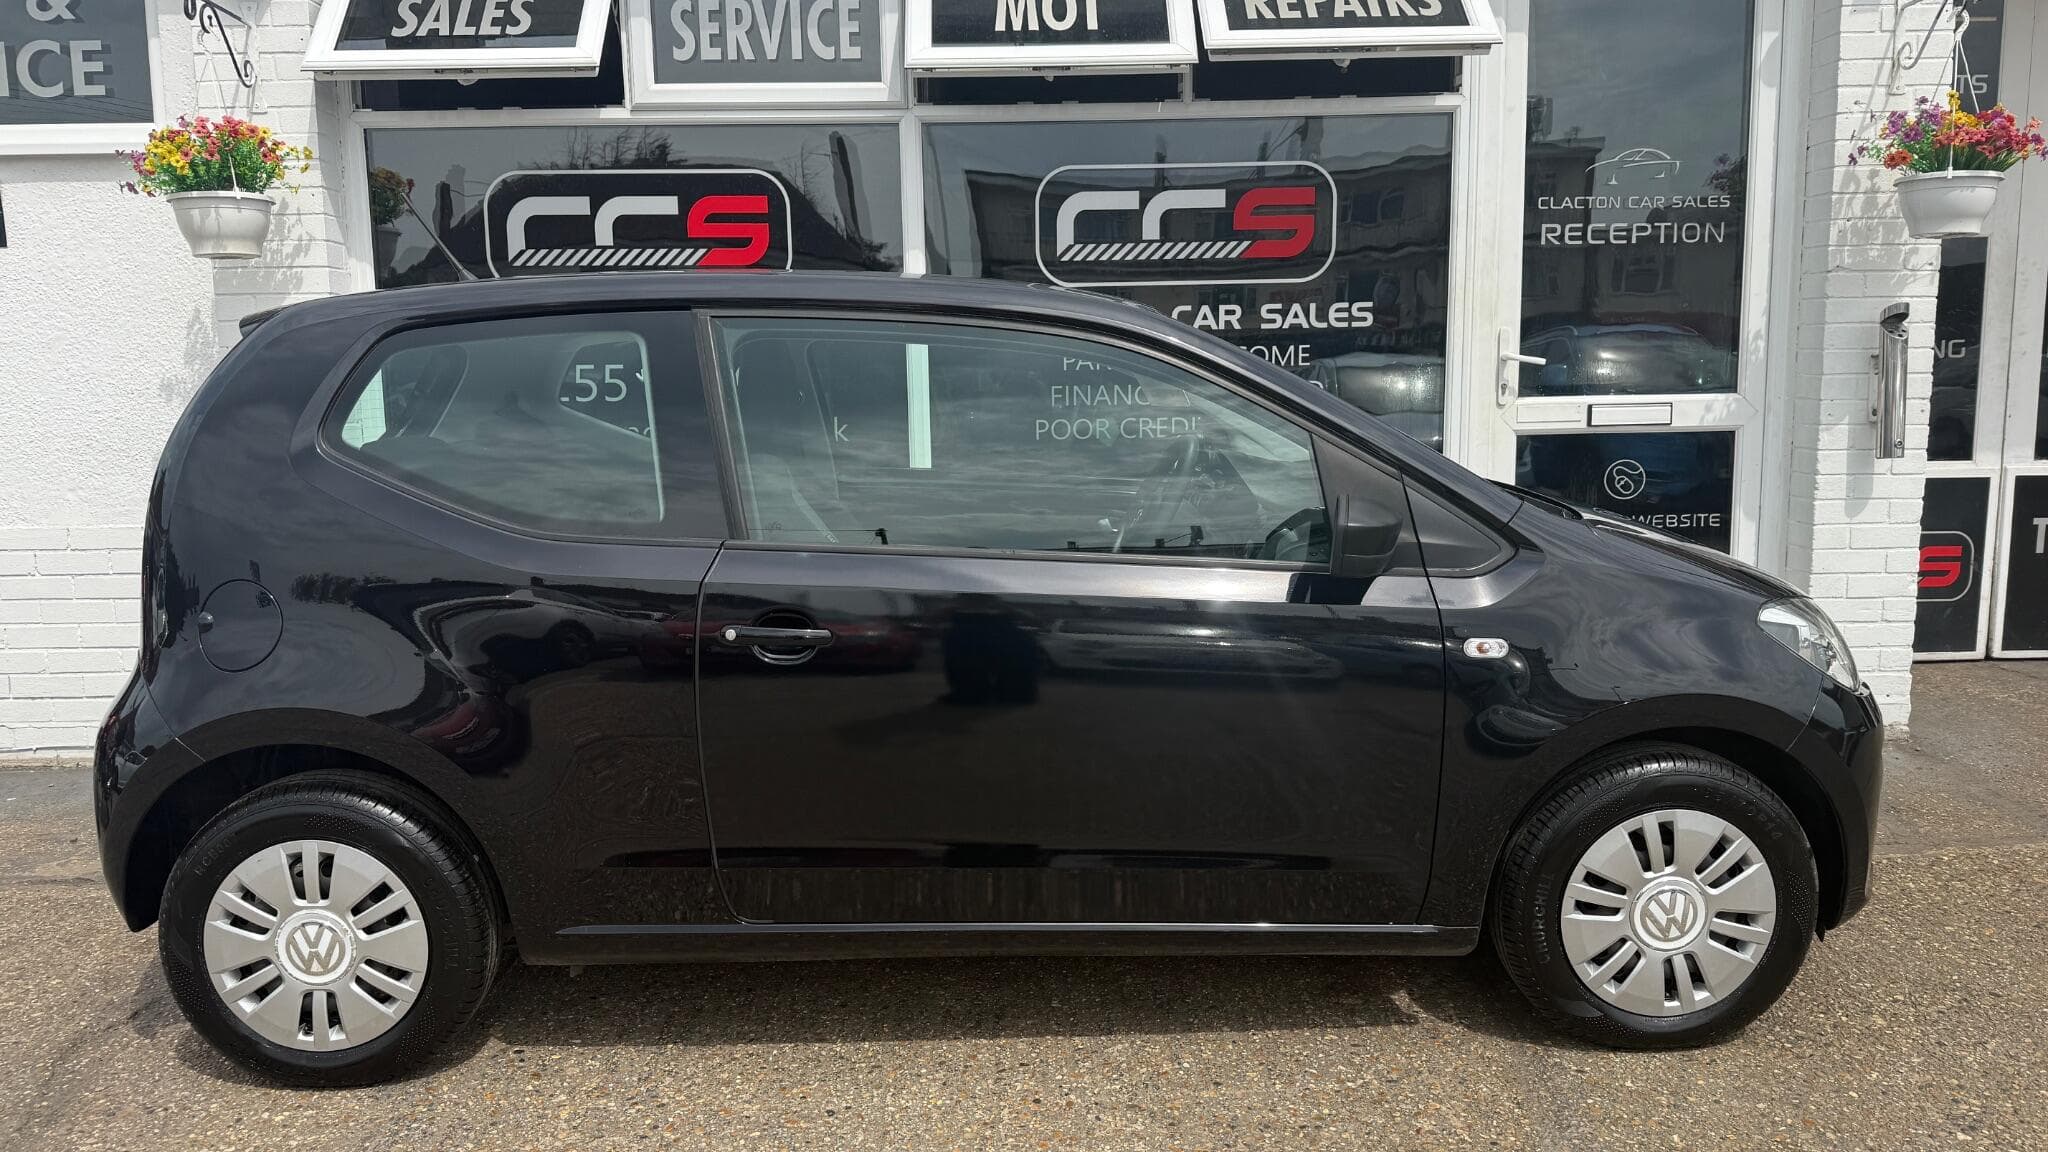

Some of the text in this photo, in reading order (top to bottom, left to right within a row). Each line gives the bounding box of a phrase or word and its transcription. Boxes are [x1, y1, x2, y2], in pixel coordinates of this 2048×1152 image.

[391, 0, 534, 37] SALES
[670, 0, 863, 61] SERVICE
[994, 0, 1098, 31] MOT
[1538, 195, 1731, 210] CLACTON CAR SALES
[1540, 222, 1726, 246] RECEPTION
[1171, 301, 1374, 331] CAR SALES
[1239, 344, 1311, 367] OME
[560, 364, 627, 402] 55
[1035, 416, 1204, 440] POOR CREDI
